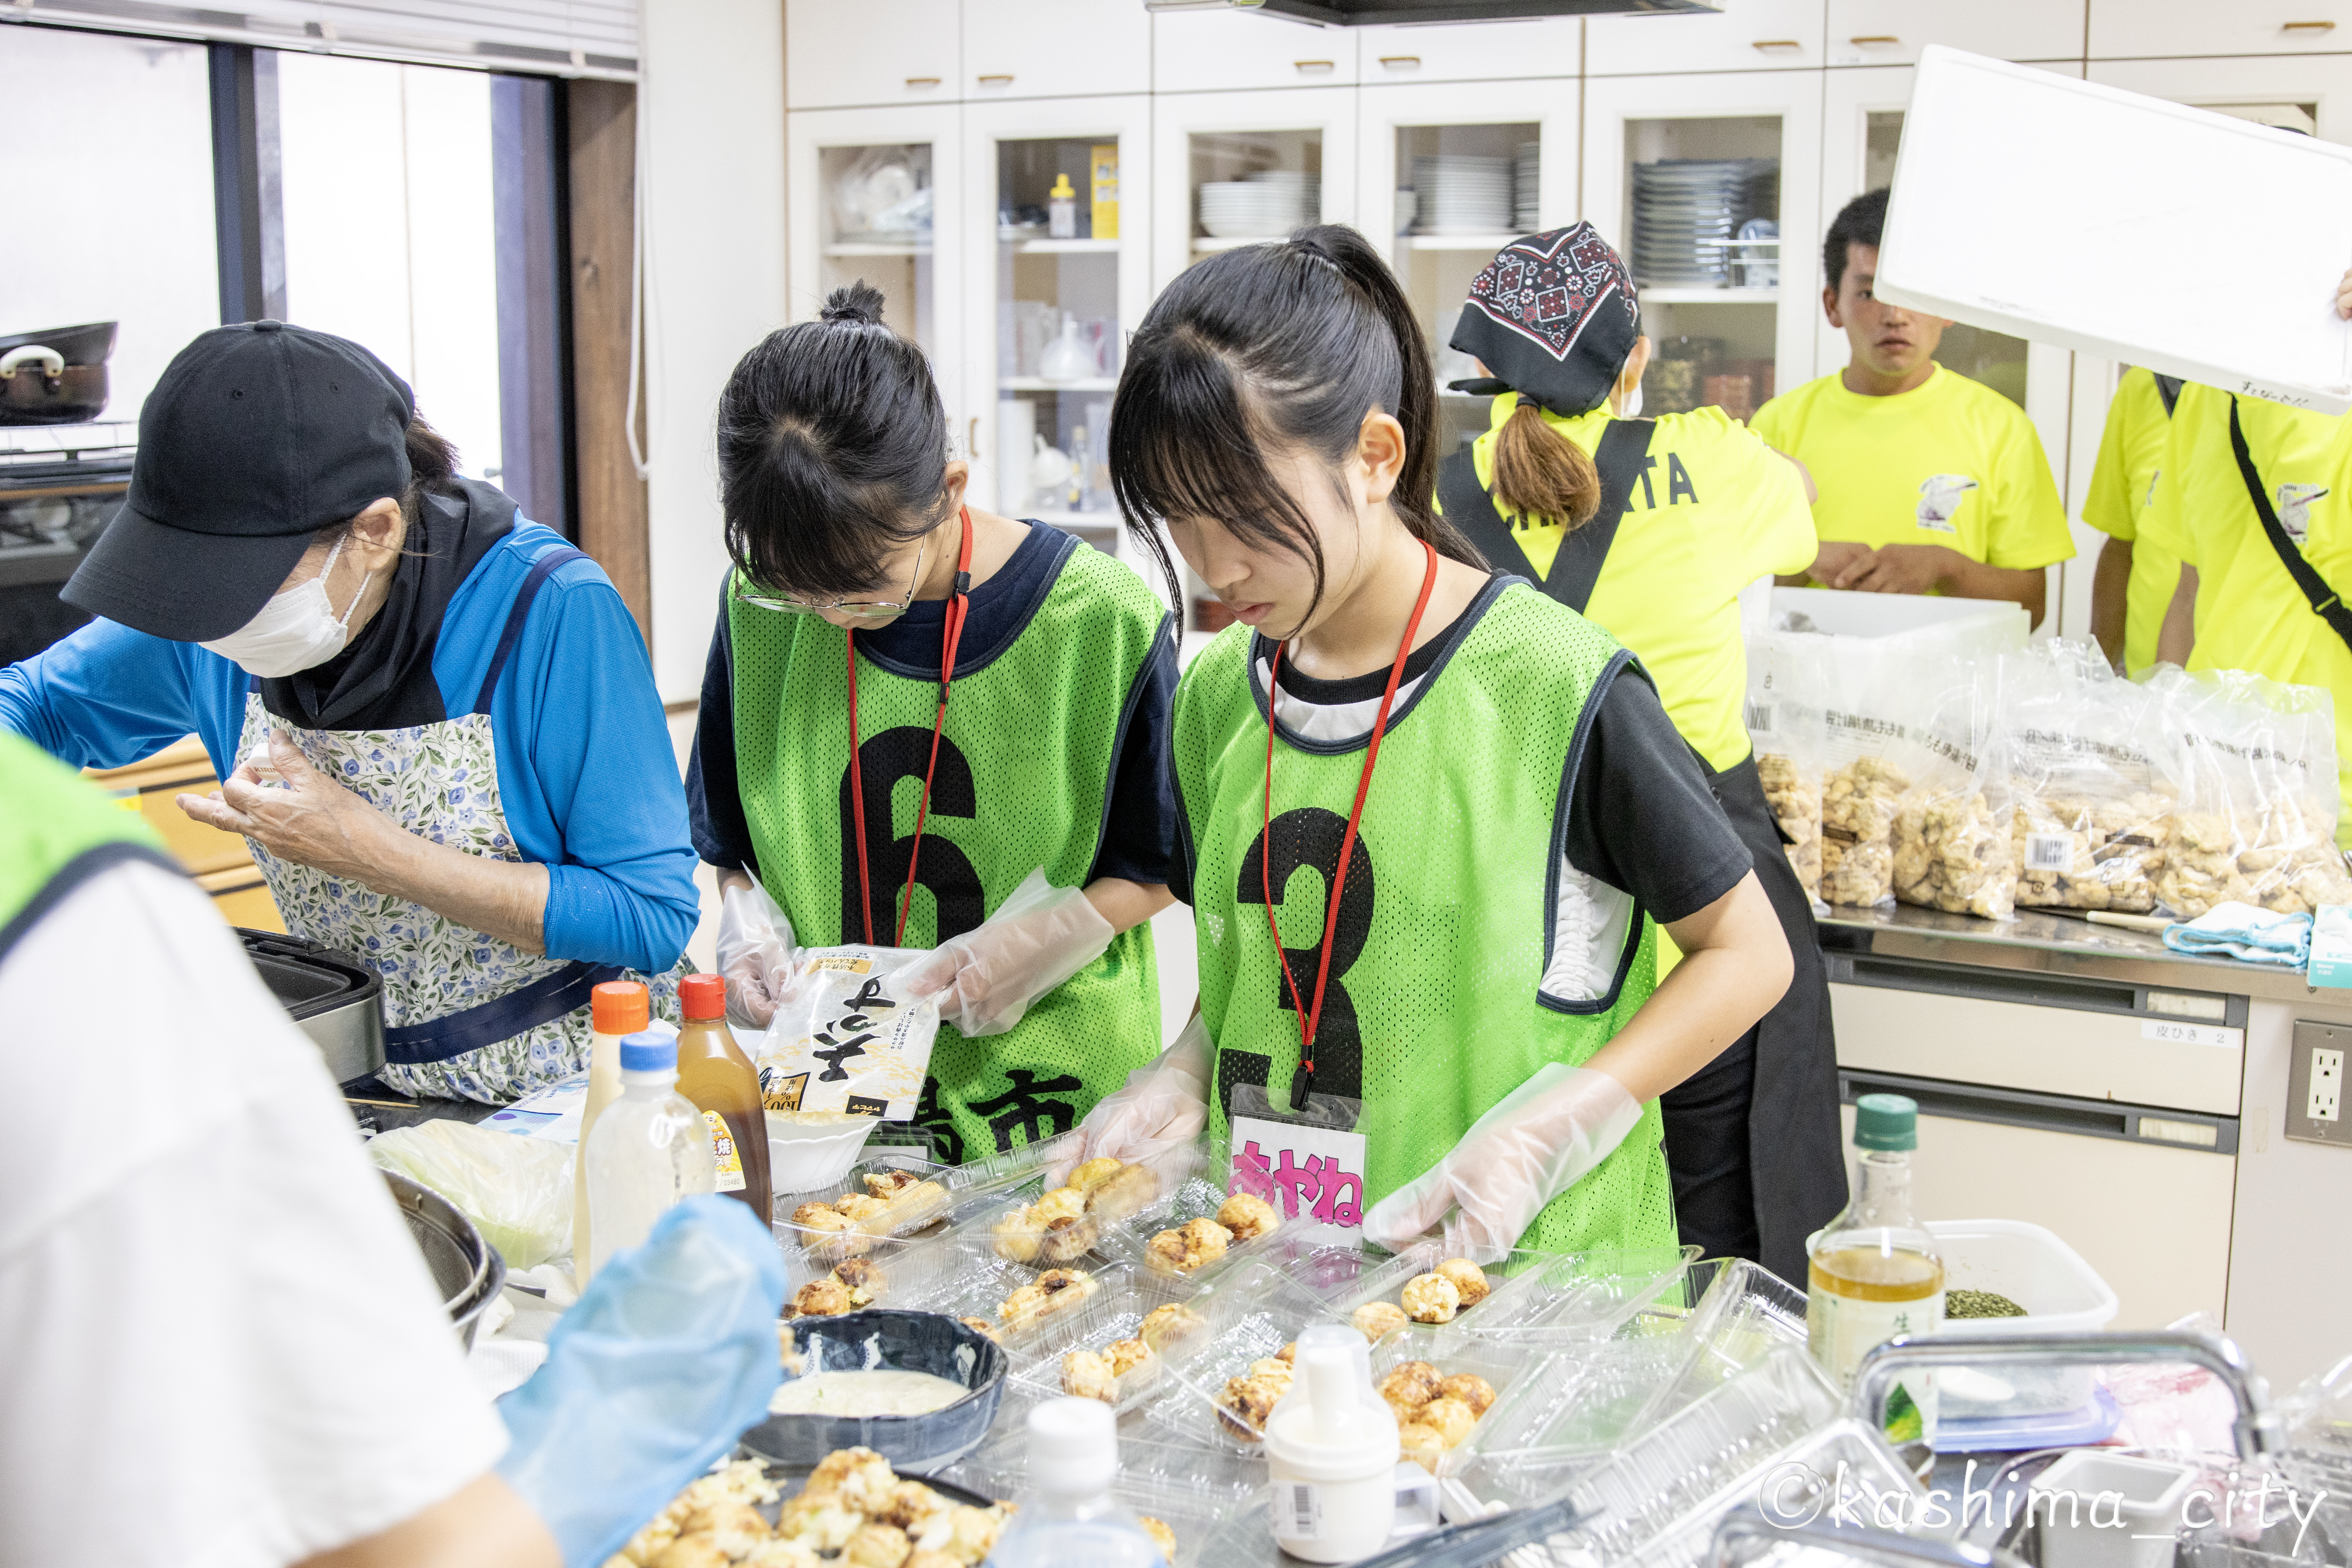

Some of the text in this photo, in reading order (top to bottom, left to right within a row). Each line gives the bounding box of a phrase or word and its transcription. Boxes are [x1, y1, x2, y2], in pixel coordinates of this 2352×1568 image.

[840, 726, 984, 1026] 6
[1219, 807, 1374, 1135] 3
[813, 973, 896, 1082] 天かす
[1227, 1140, 1363, 1228] あやね
